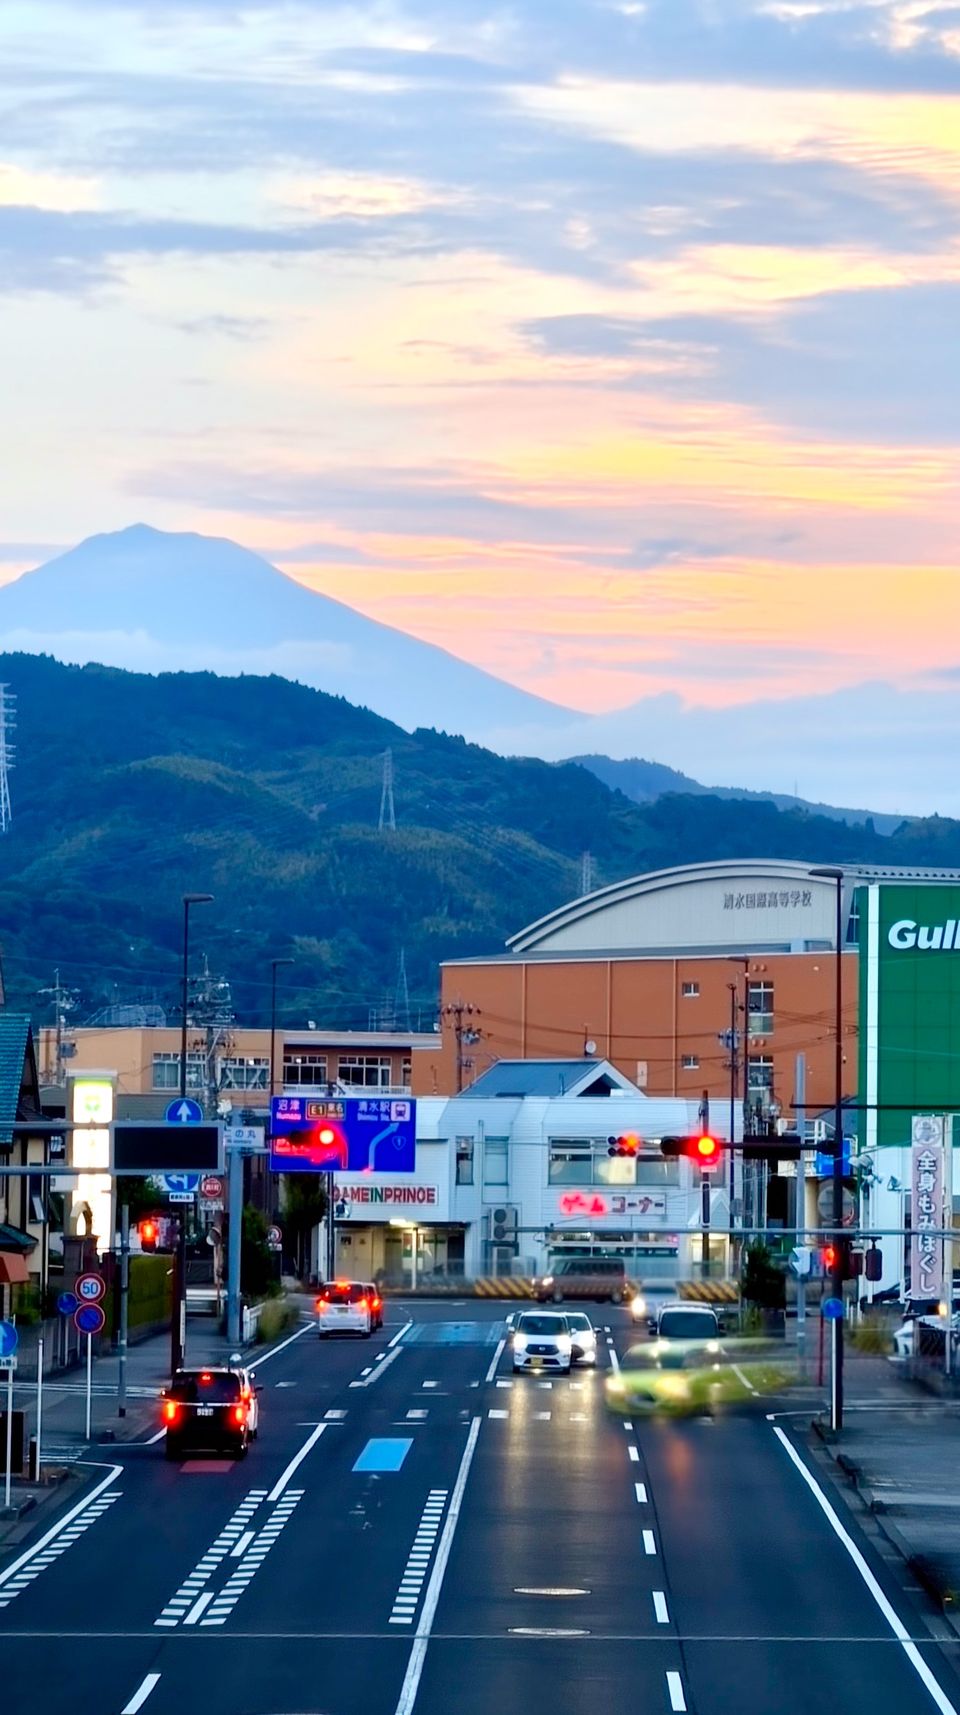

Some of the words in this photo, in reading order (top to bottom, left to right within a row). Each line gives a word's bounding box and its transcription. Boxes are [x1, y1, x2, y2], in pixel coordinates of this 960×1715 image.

[311, 1105, 323, 1115] E1
[917, 1150, 937, 1293] 全身もみほぐし
[83, 1281, 99, 1295] 50
